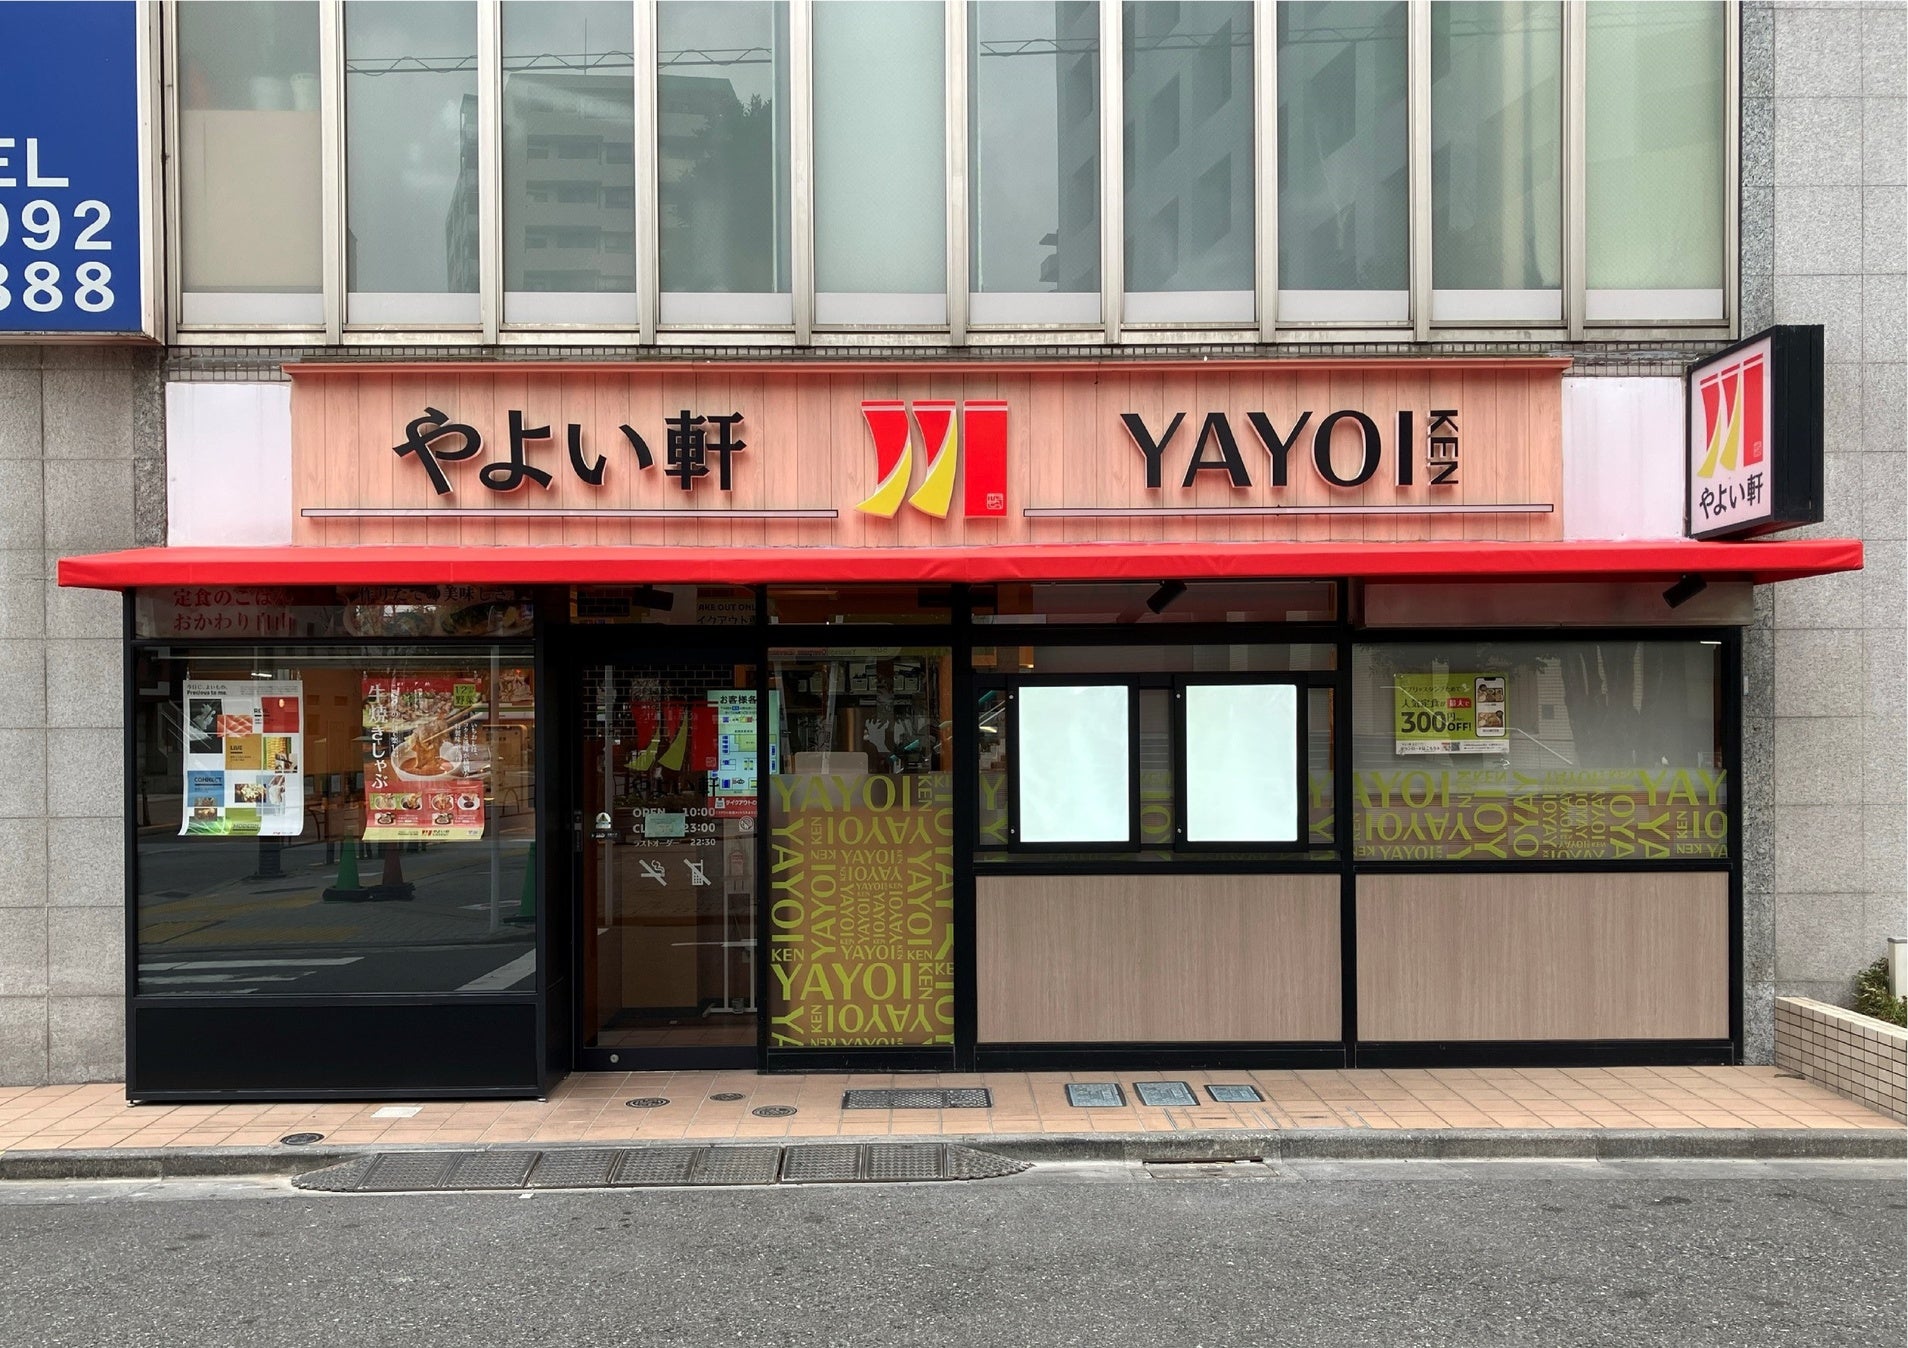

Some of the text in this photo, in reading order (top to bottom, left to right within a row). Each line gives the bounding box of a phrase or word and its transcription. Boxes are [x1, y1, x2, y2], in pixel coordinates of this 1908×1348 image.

[0, 199, 112, 251] 92
[0, 261, 115, 312] 88
[392, 406, 748, 495] やよい軒
[1119, 409, 1459, 488] YAYOI KEN
[1699, 472, 1763, 519] やよい軒
[1401, 711, 1447, 733] 300
[1447, 723, 1472, 732] OFF!
[772, 775, 932, 812] YAYOI KEN
[682, 807, 715, 817] 10:00
[690, 838, 716, 847] 22:30
[811, 816, 822, 844] KEN
[811, 850, 836, 860] KEN
[840, 849, 895, 864] YAYOI
[771, 817, 804, 961] YAYOI KEN
[907, 850, 932, 960] YAYOI KEN
[840, 945, 895, 960] YAYOI
[770, 963, 933, 1001] YAYOI KEN
[811, 1004, 822, 1032] KEN
